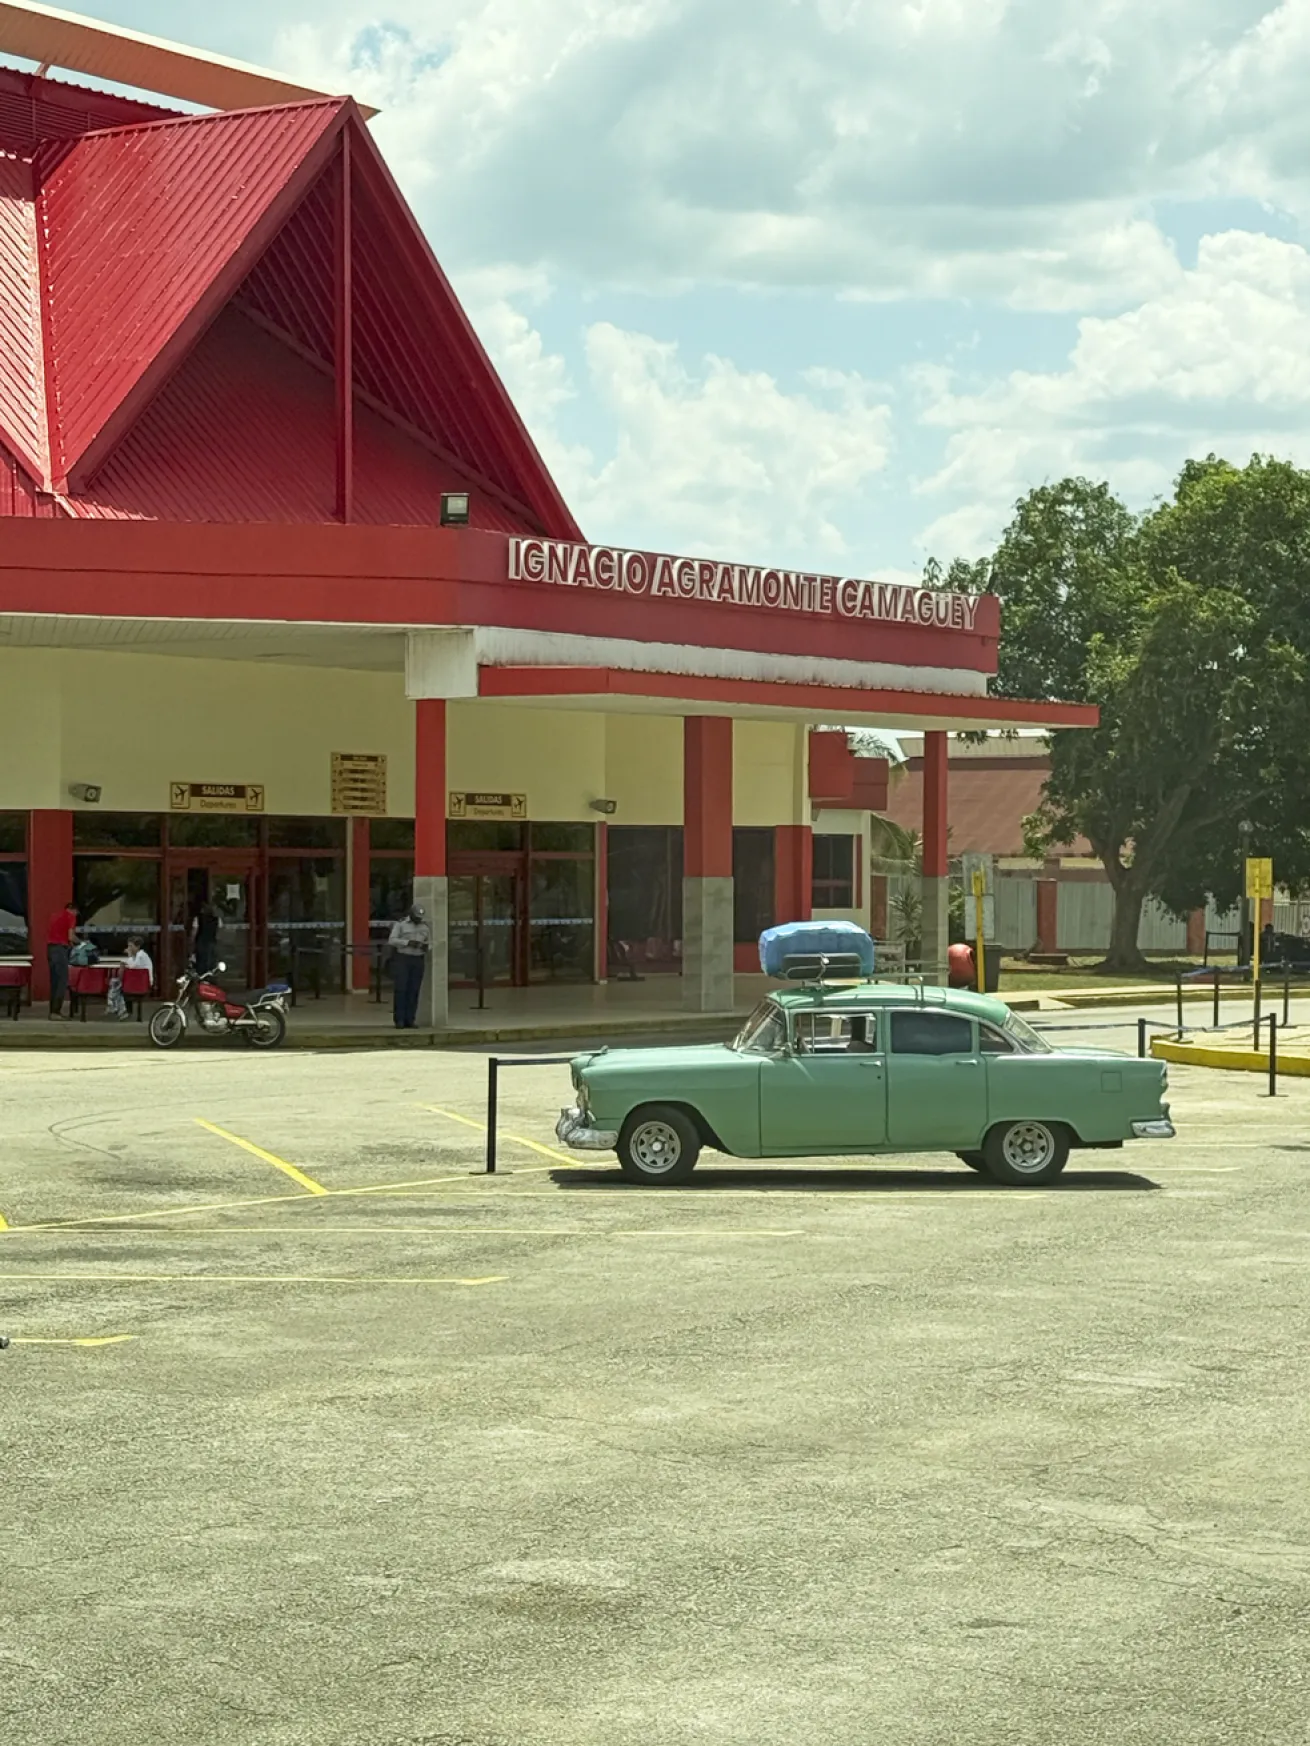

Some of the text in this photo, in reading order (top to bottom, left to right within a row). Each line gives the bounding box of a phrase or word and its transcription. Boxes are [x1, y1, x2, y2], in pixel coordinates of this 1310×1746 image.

[508, 537, 979, 630] IGNACIO AGRAMONTE CAMAGÜEY
[201, 785, 235, 796] SALIDAS
[474, 795, 502, 805] SALIDAS
